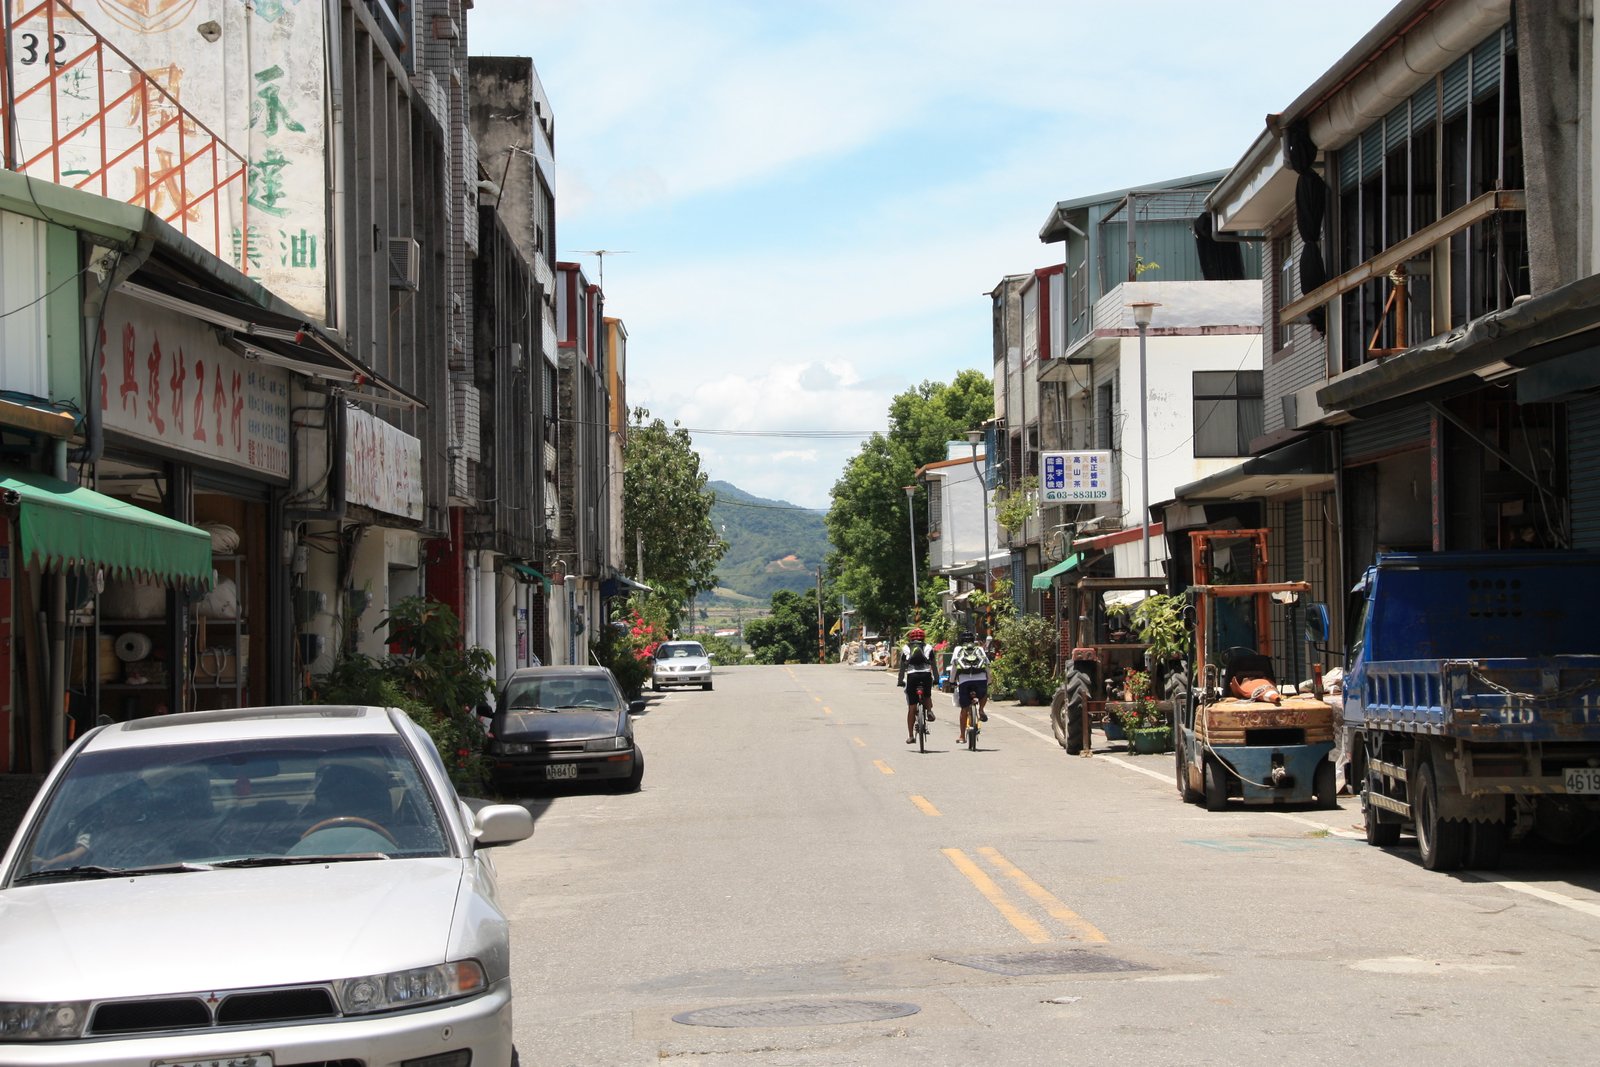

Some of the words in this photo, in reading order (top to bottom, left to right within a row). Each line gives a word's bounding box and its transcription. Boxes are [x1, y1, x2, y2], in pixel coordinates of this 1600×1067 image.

[21, 33, 67, 68] 32
[279, 228, 317, 269] 油
[1073, 456, 1081, 488] 高山茶
[1056, 490, 1107, 500] 03-8831139
